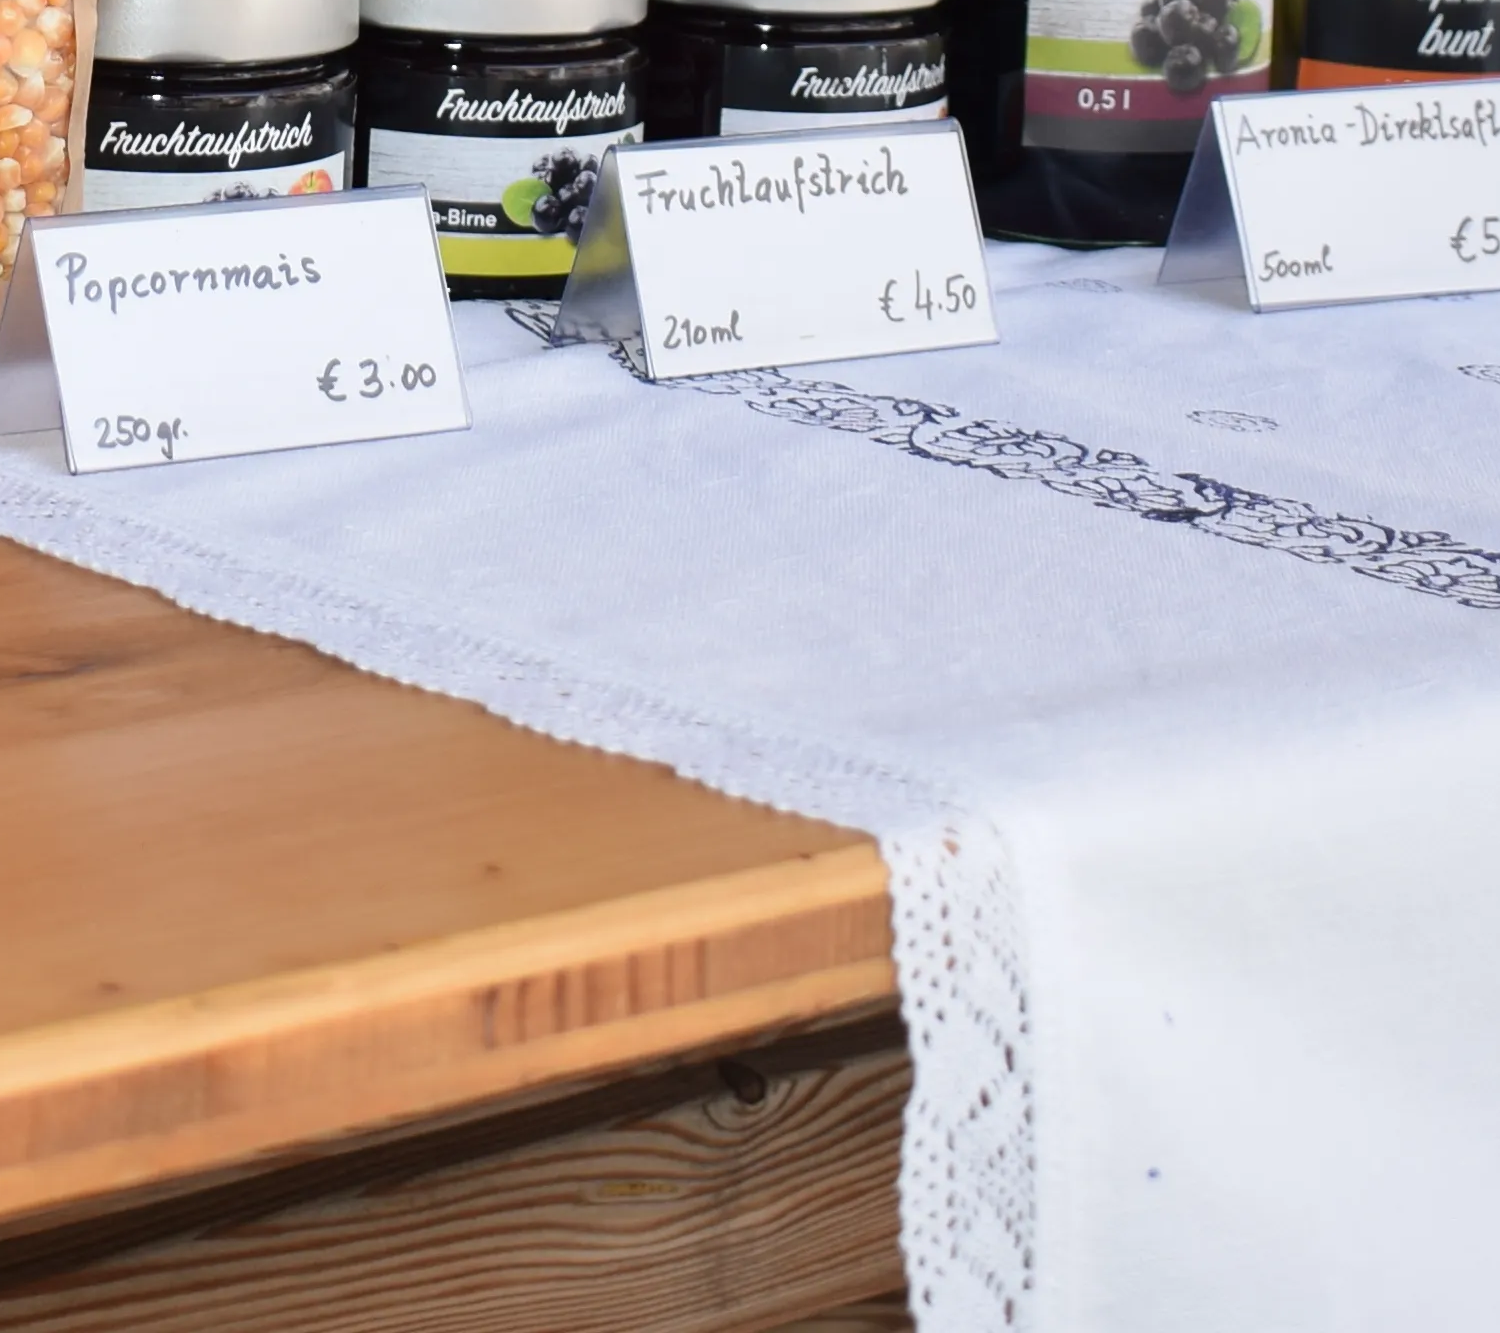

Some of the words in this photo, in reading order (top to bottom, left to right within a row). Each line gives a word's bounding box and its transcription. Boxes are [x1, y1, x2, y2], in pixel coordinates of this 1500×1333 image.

[1418, 14, 1495, 57] bunt
[791, 54, 946, 105] Fruchtaufstrich
[1078, 88, 1116, 112] 0,5
[436, 82, 627, 134] Fruchtaufstrich
[99, 111, 313, 168] Fruchtaufstrich
[634, 146, 909, 215] Fruchtaufstrich
[1258, 244, 1334, 282] 500ml
[1449, 216, 1478, 263] €
[55, 251, 323, 315] Popcornmais
[878, 278, 905, 322] €
[914, 269, 977, 321] 4.50
[315, 358, 347, 402] €
[358, 356, 437, 399] 3.00
